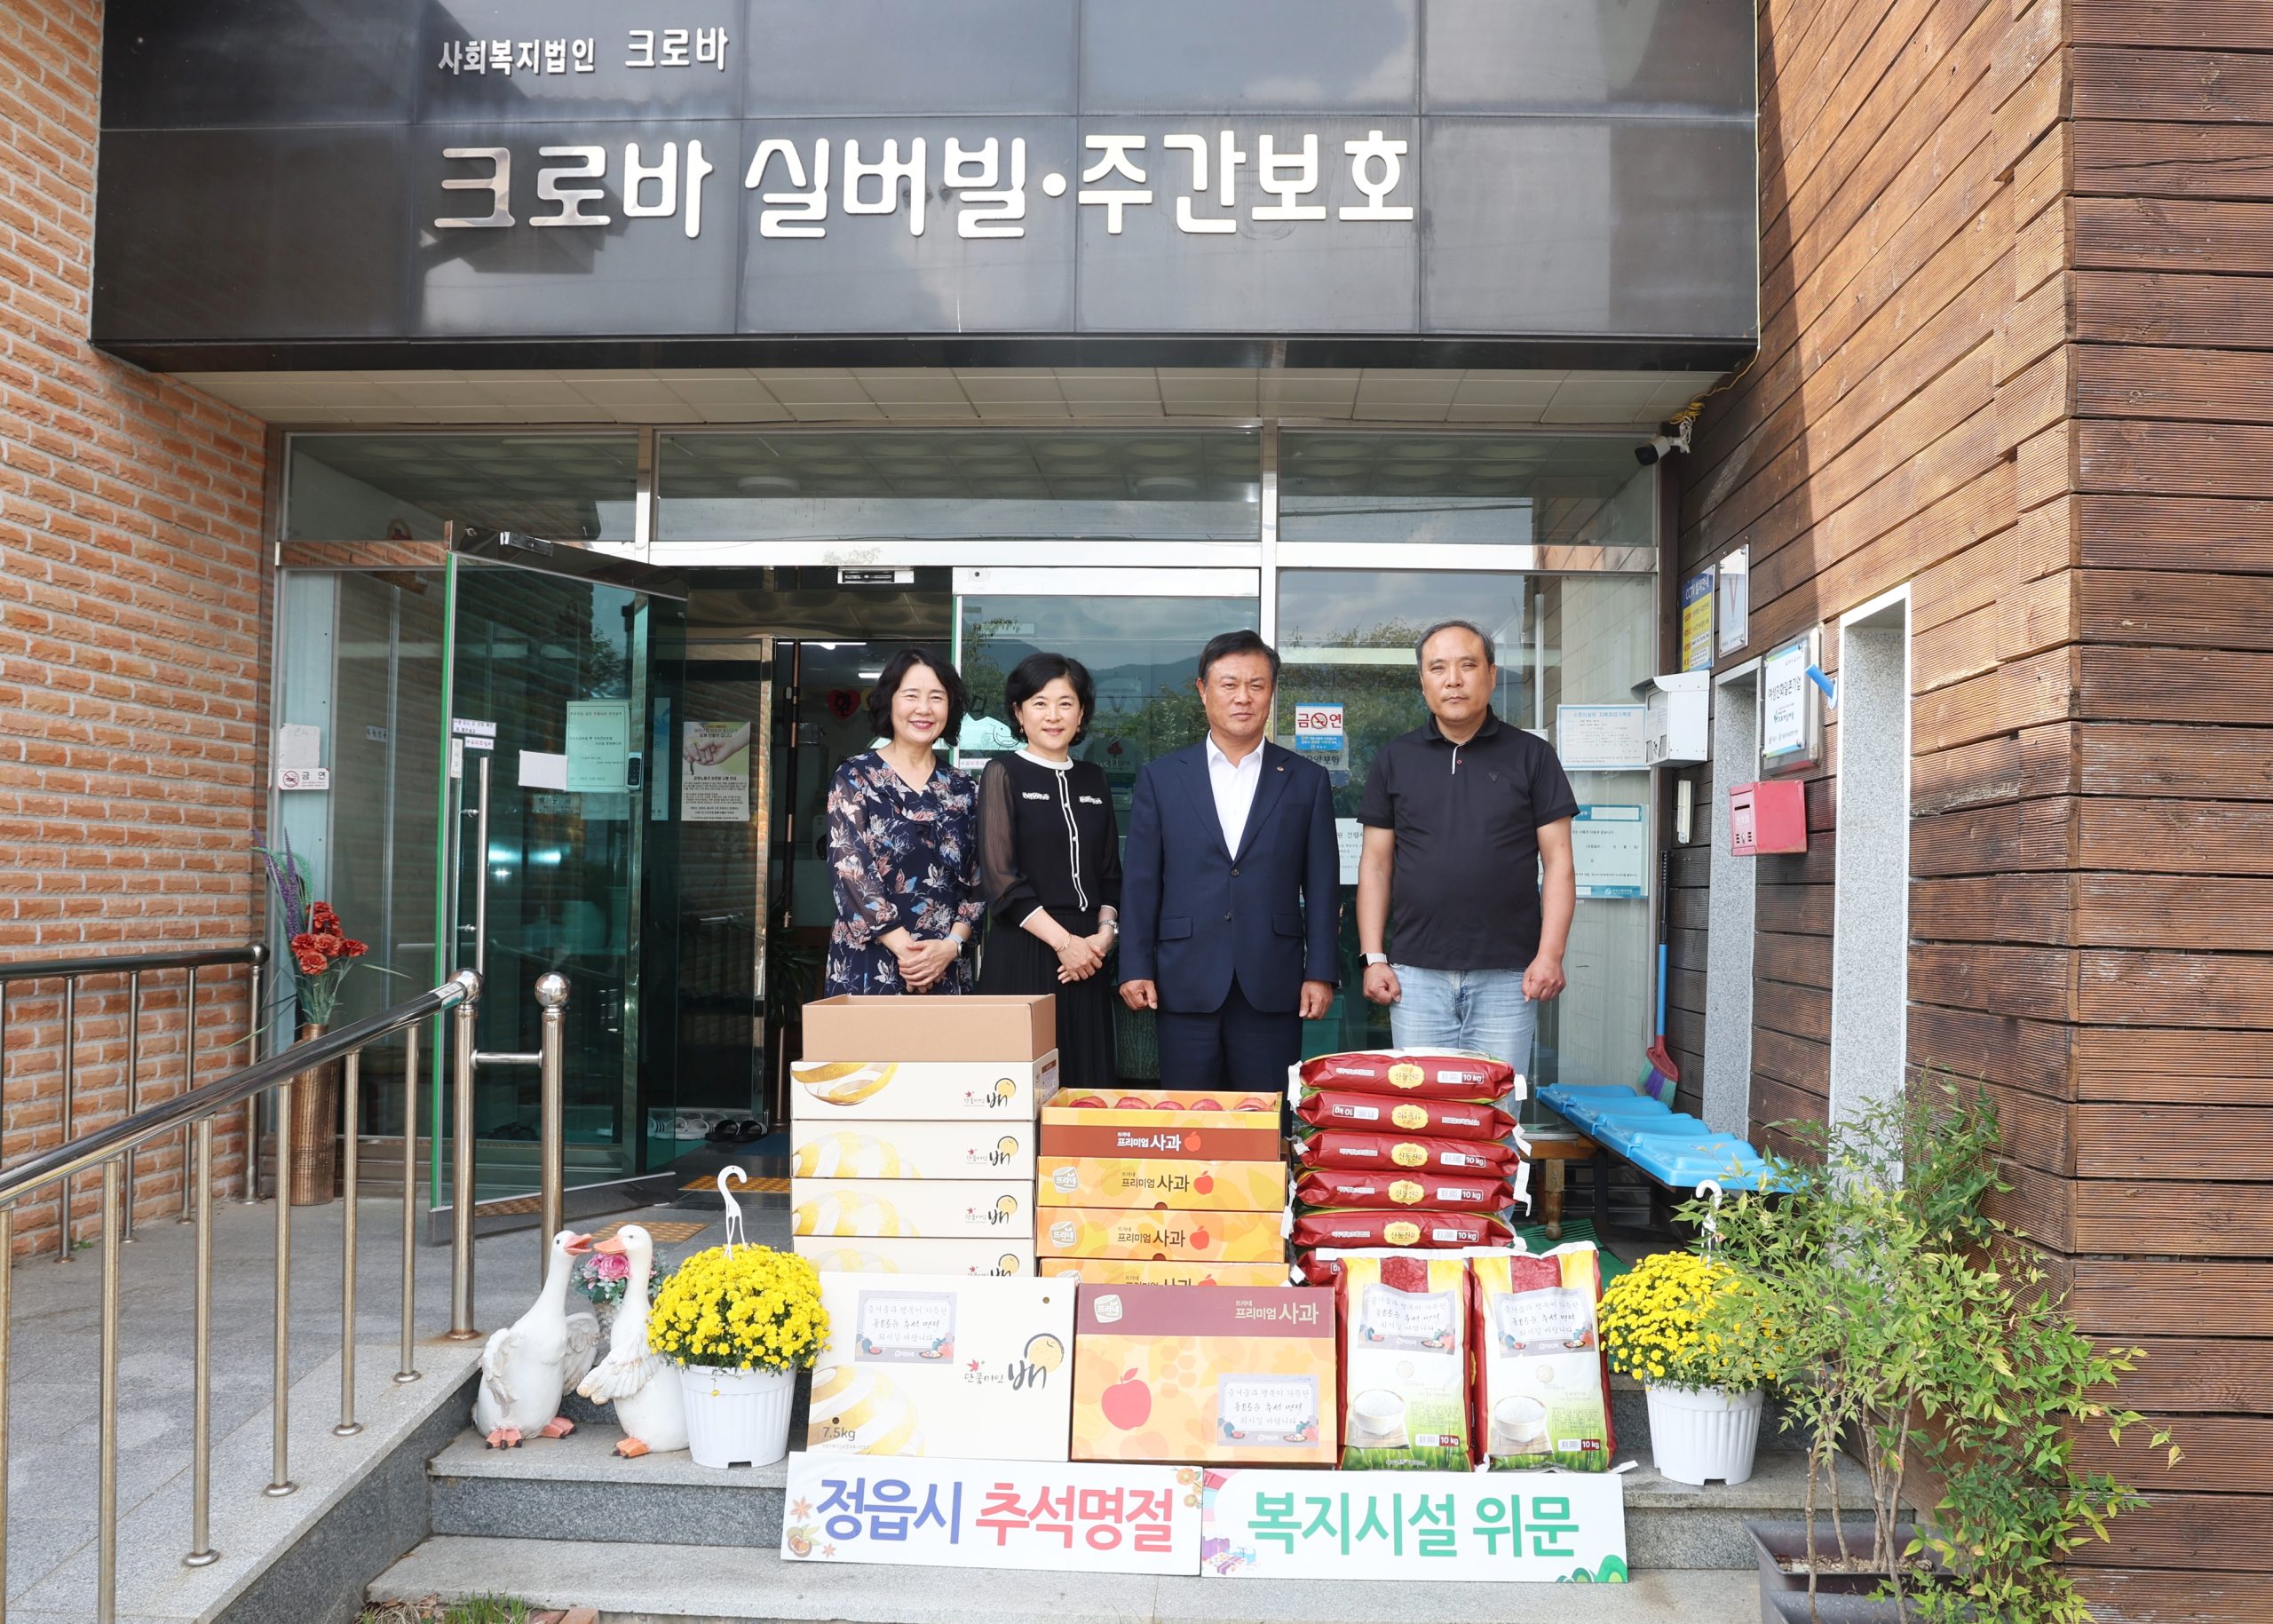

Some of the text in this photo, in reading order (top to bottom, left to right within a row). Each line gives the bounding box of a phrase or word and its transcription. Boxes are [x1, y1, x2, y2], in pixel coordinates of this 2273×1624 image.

[438, 27, 729, 76] 사회복지법인 크로바
[434, 139, 714, 239] 크로바
[1297, 713, 1342, 728] 금 연
[1116, 1134, 1182, 1152] 프리미엄 사과
[1475, 1157, 1485, 1167] kg
[1121, 1174, 1190, 1192] 프리미엄 사과
[1471, 1191, 1482, 1200] kg
[1117, 1229, 1186, 1248] 프리미엄 사과
[1467, 1232, 1477, 1241] kg
[1235, 1302, 1319, 1325] 프리미엄 사과
[964, 1359, 1047, 1391] 단풍미인 배
[822, 1426, 856, 1442] 7.5kg
[1450, 1437, 1459, 1446] kg
[816, 1477, 1173, 1553] 정읍시 추석명절
[1247, 1491, 1580, 1558] 복지시설 위문
